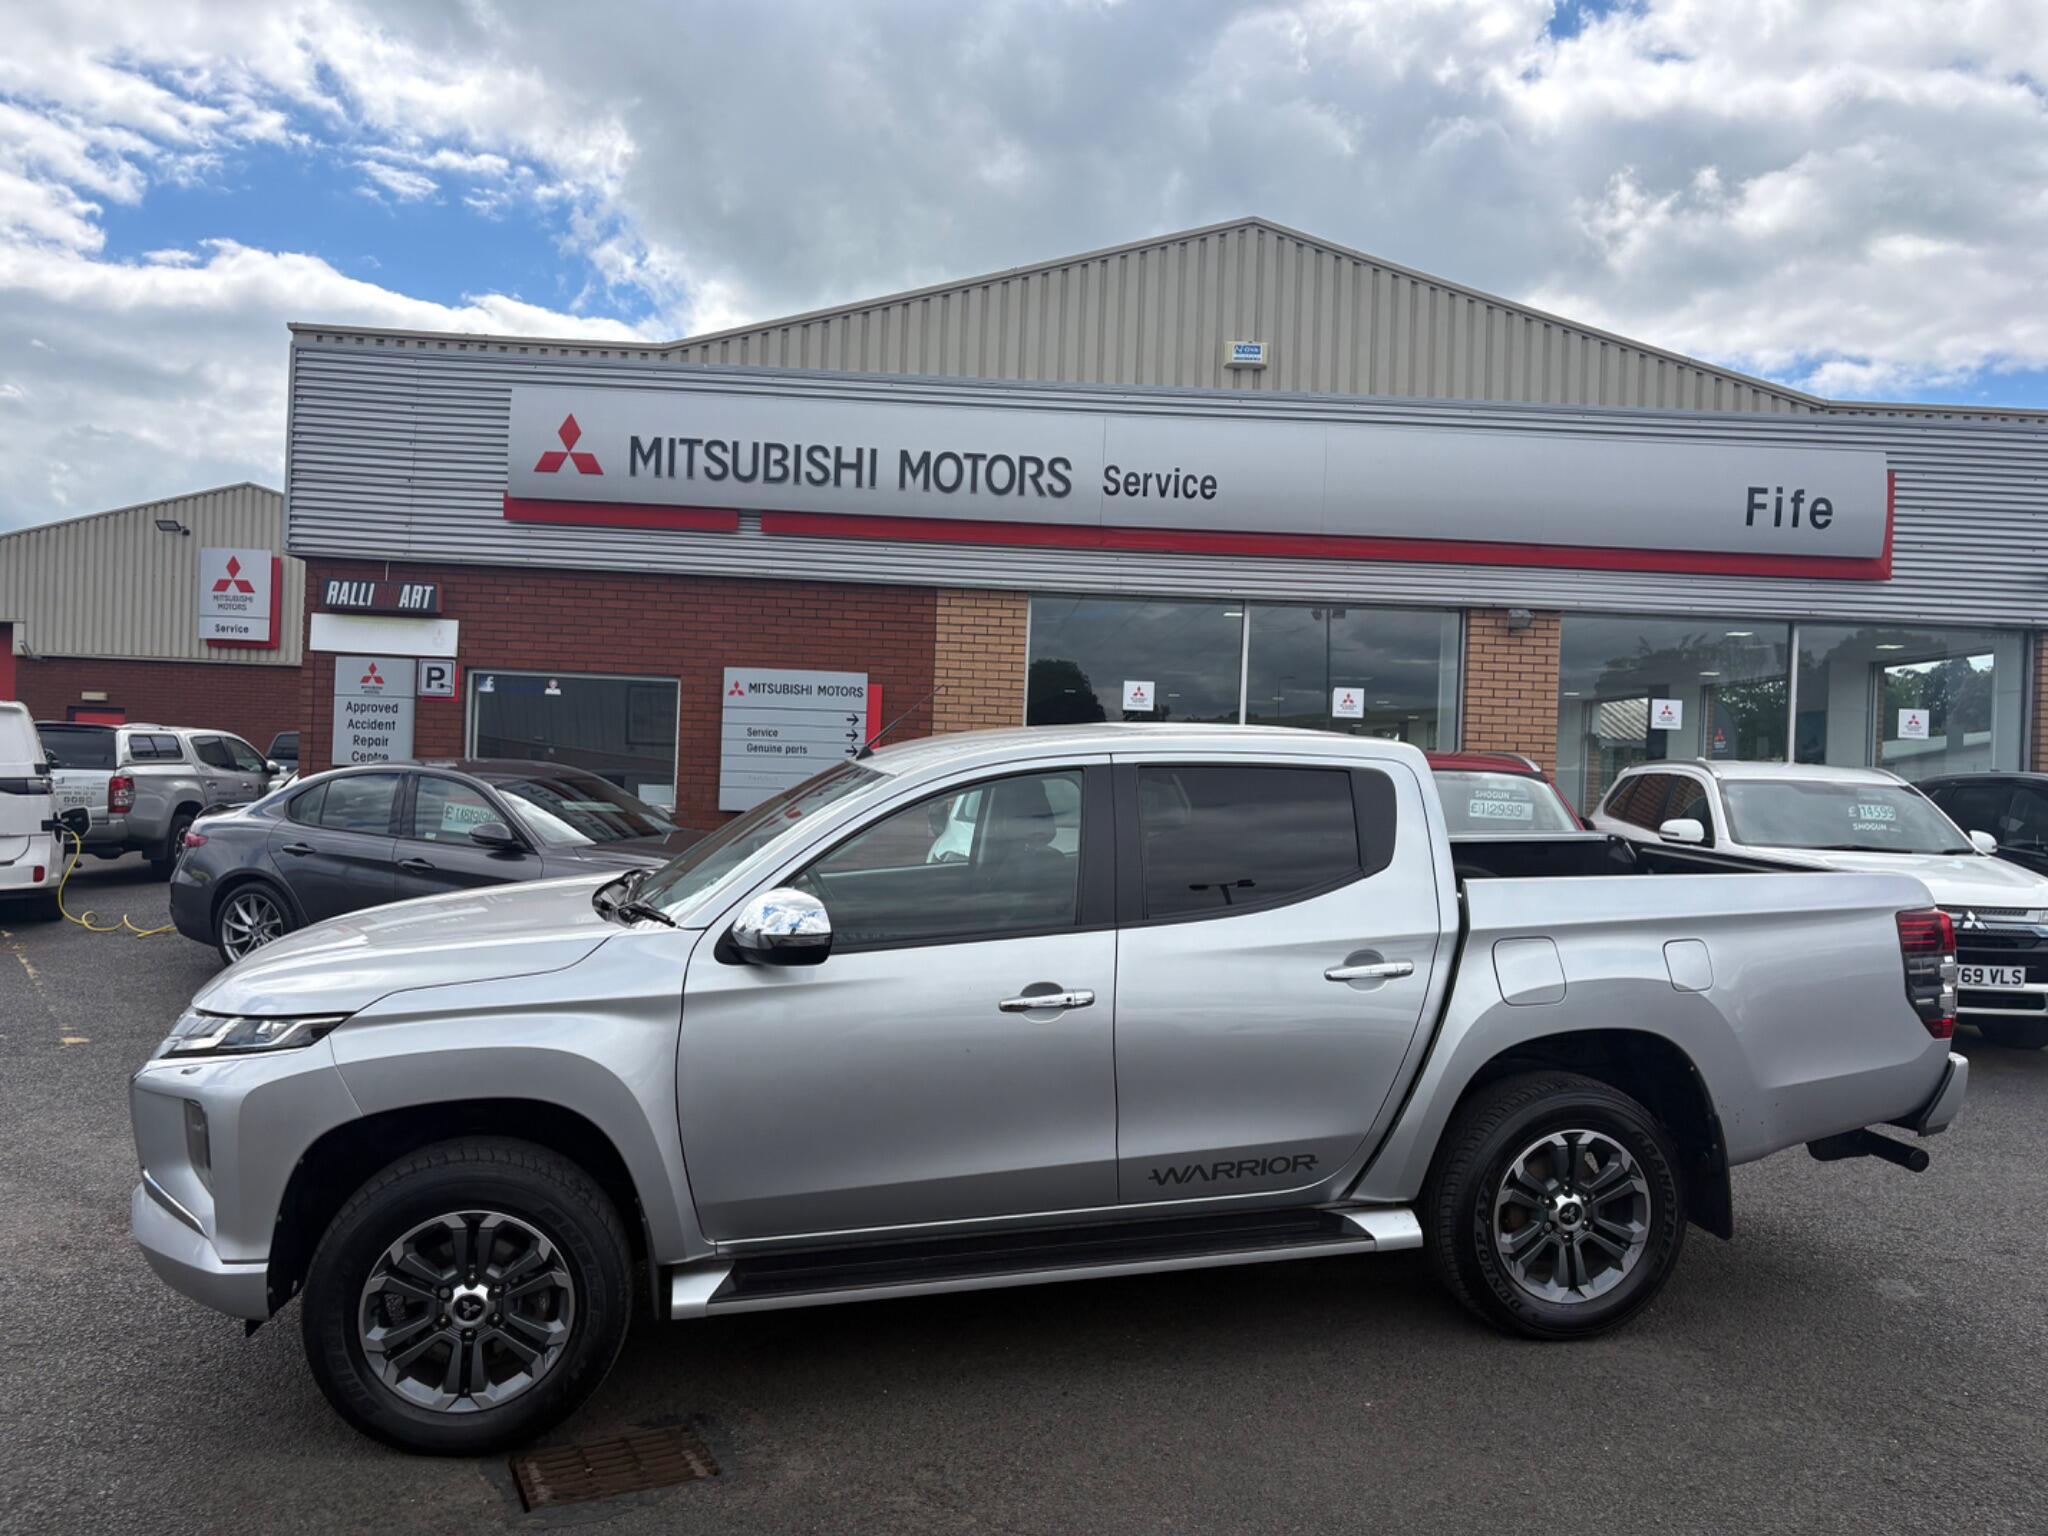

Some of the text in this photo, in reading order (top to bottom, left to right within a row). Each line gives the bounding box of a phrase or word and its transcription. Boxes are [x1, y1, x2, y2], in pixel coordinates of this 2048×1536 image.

[629, 435, 1218, 501] MITSUBISHI MOTORS Service
[1745, 485, 1834, 530] Fife
[325, 580, 434, 609] RALLI ART
[214, 623, 249, 634] Service
[425, 667, 446, 689] P
[748, 682, 864, 698] MITSUBISHI MOTORS
[345, 701, 399, 714] Approved
[347, 719, 396, 731] Accident
[746, 727, 778, 738] Service
[352, 734, 389, 748] Repair
[746, 743, 808, 756] Genuine parts
[1474, 790, 1510, 800] SHOGUN
[1957, 967, 2022, 985] 69 VLS
[1147, 1154, 1319, 1186] WARRIOR
